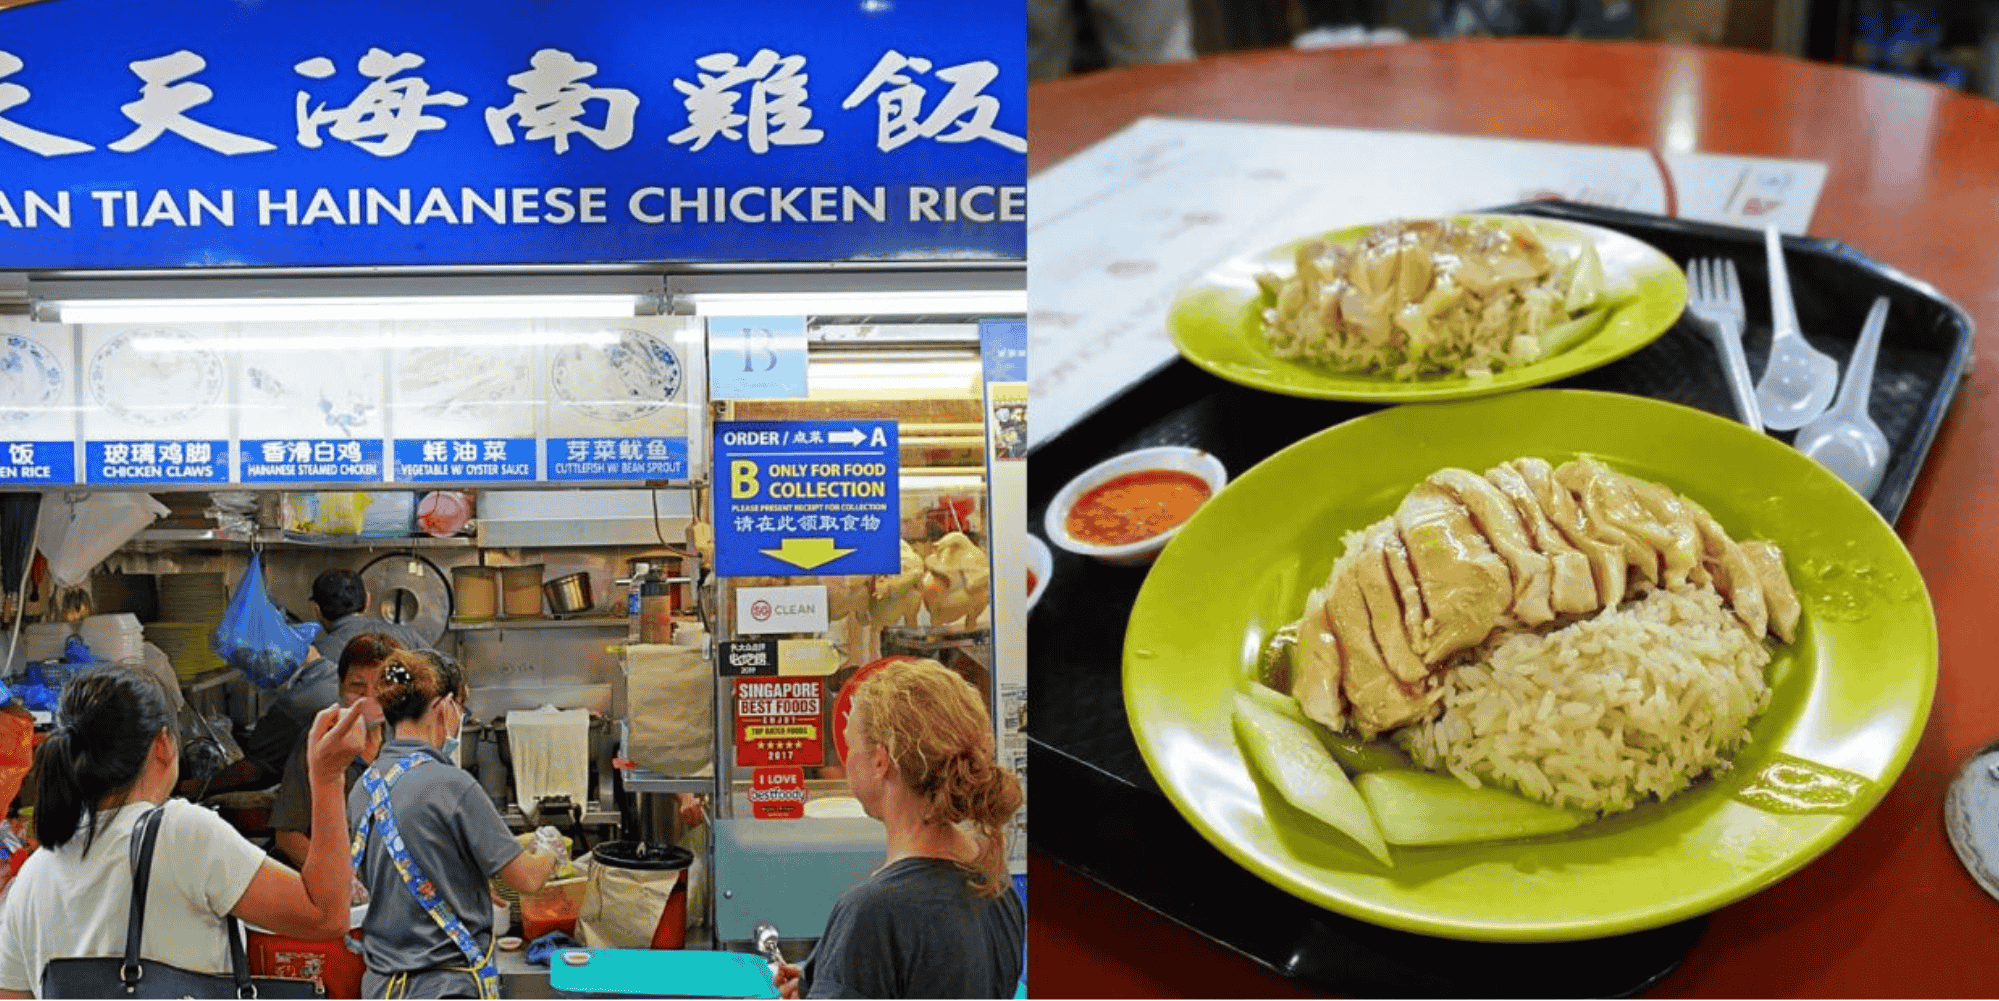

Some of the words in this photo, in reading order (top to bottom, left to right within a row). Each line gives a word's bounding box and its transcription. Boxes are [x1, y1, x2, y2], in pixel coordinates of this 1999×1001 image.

[93, 188, 235, 228] TIAN
[259, 187, 607, 227] HAINANESE
[629, 185, 887, 224] CHICKEN
[909, 185, 1027, 223] RICE
[724, 431, 779, 446] ORDER
[782, 430, 789, 446] /
[792, 430, 825, 444] 点菜
[870, 427, 888, 447] A
[8, 443, 35, 465] 饭
[103, 442, 211, 465] 玻璃鸡脚
[261, 441, 363, 462] 香滑白鸡
[422, 440, 508, 462] 蚝油菜
[566, 440, 670, 461] 芽菜鱿鱼
[21, 466, 51, 478] RICE
[103, 465, 162, 477] CHICKEN
[166, 465, 213, 477] CLAWS
[248, 464, 296, 476] HAINANESE
[298, 464, 338, 475] STEAMED
[340, 463, 378, 475] CHICKEN
[401, 463, 448, 476] VEGETABLE
[466, 463, 500, 475] OYSTER
[502, 463, 530, 475] SAUCE
[555, 462, 604, 474] CUTTLEFISH
[621, 462, 645, 473] BEAN
[647, 461, 681, 473] SPROUT
[769, 464, 808, 478] ONLY
[811, 464, 841, 477] FOR
[844, 463, 887, 477] FOOD
[731, 459, 760, 499] B
[769, 481, 886, 499] COLLECTION
[731, 504, 758, 512] PLEASE
[760, 504, 792, 512] PRESENT
[841, 503, 888, 511] COLLECTION
[733, 514, 882, 533] 请在此领取食物
[774, 604, 815, 616] CLEAN
[739, 682, 819, 698] SINGAPORE
[741, 700, 771, 714] BEST
[776, 699, 817, 713] FOODS
[768, 751, 793, 760] 2017
[759, 774, 765, 784] I
[768, 774, 797, 784] LOVE
